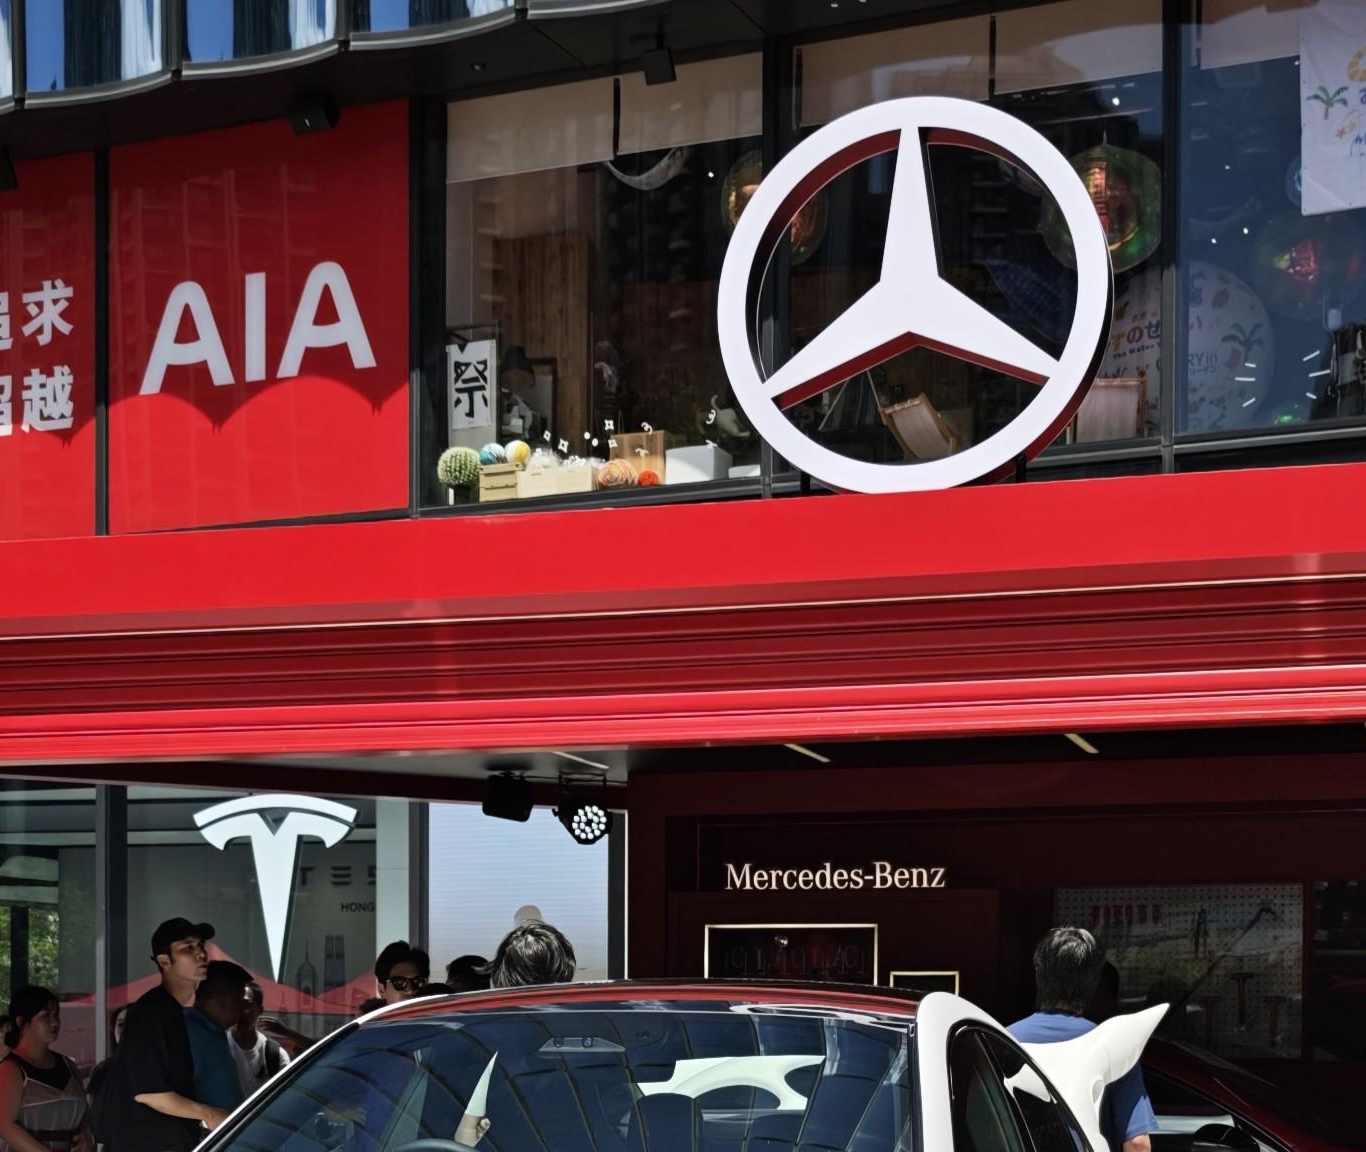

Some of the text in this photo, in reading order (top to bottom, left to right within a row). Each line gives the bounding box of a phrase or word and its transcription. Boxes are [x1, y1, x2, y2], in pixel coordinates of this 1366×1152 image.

[138, 261, 377, 396] AIA
[454, 358, 488, 418] 祭
[724, 862, 946, 891] Mercedes-Benz
[340, 902, 376, 912] HONG
